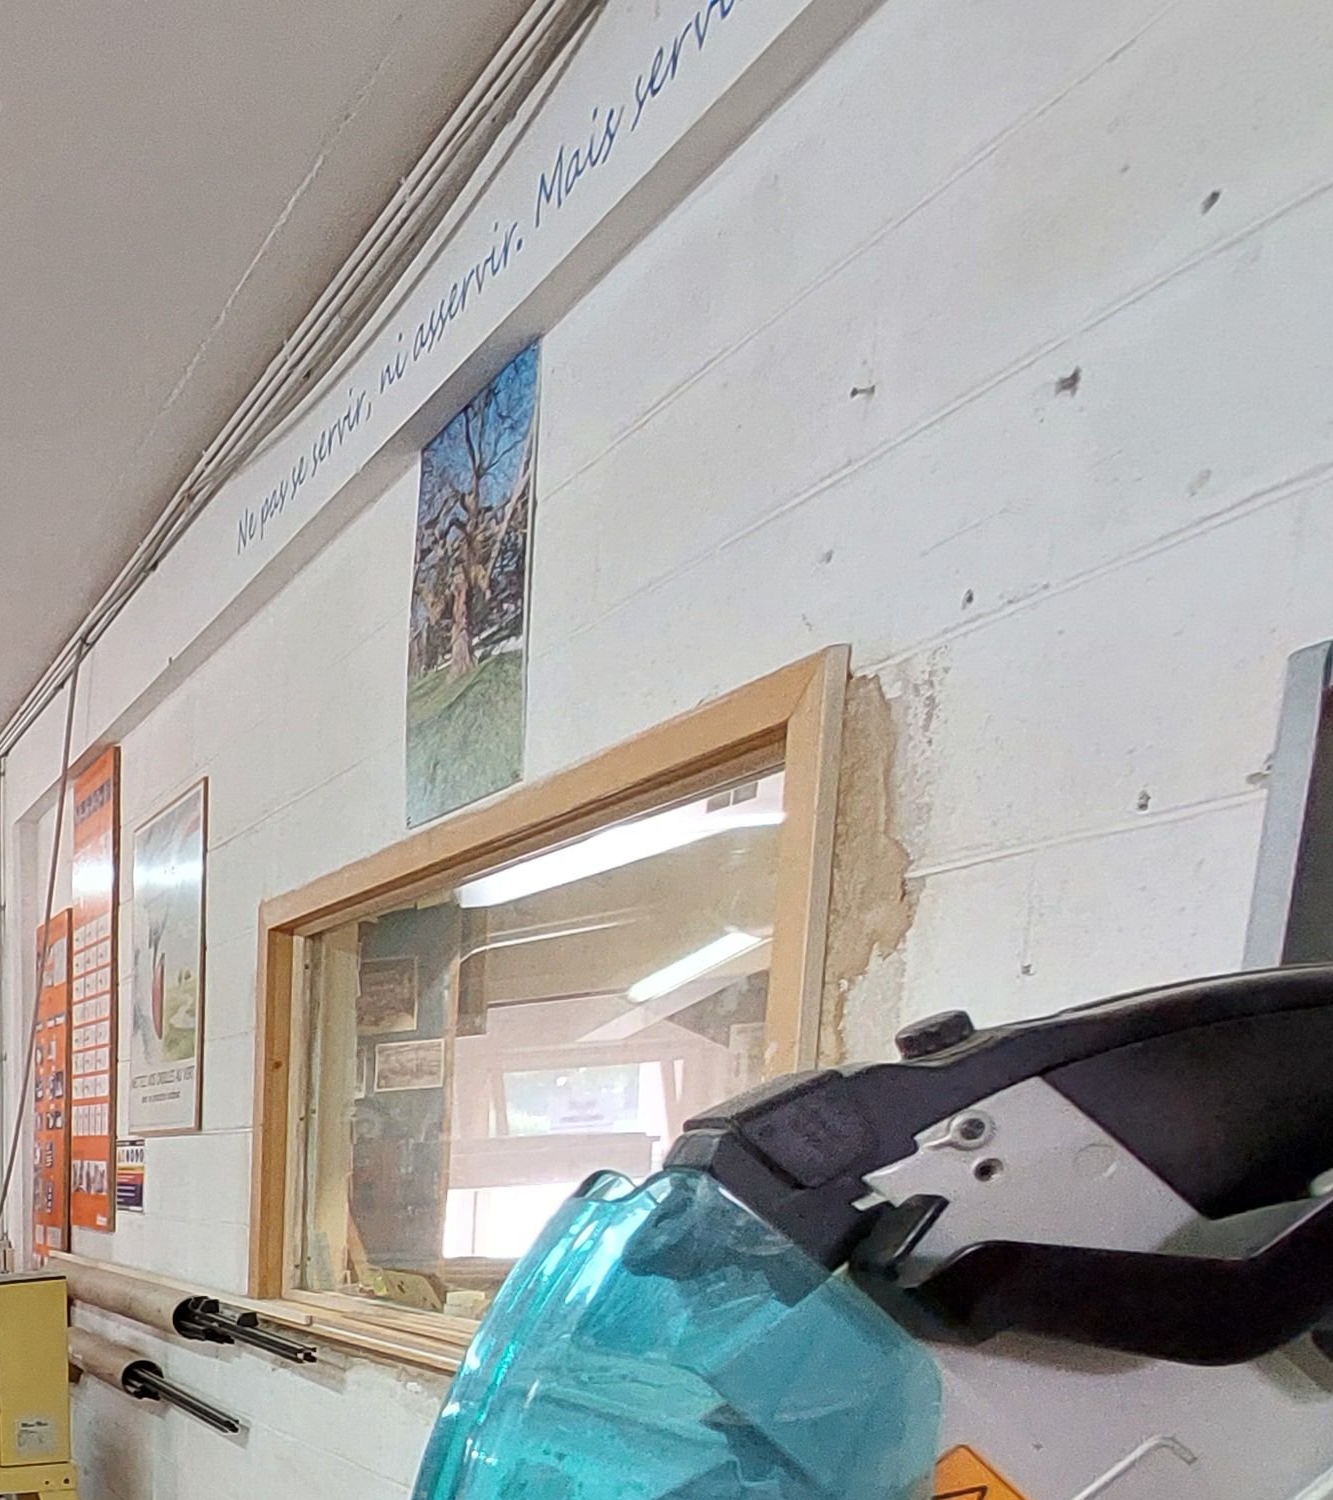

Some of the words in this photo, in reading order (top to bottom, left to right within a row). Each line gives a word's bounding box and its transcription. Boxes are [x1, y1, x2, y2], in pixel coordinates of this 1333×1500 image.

[237, 507, 257, 555] Ne
[260, 478, 289, 540] pas
[291, 456, 309, 500] se
[311, 387, 372, 477] servir,
[380, 332, 409, 394] ni
[413, 222, 523, 361] asservir.
[535, 106, 626, 228] Mais
